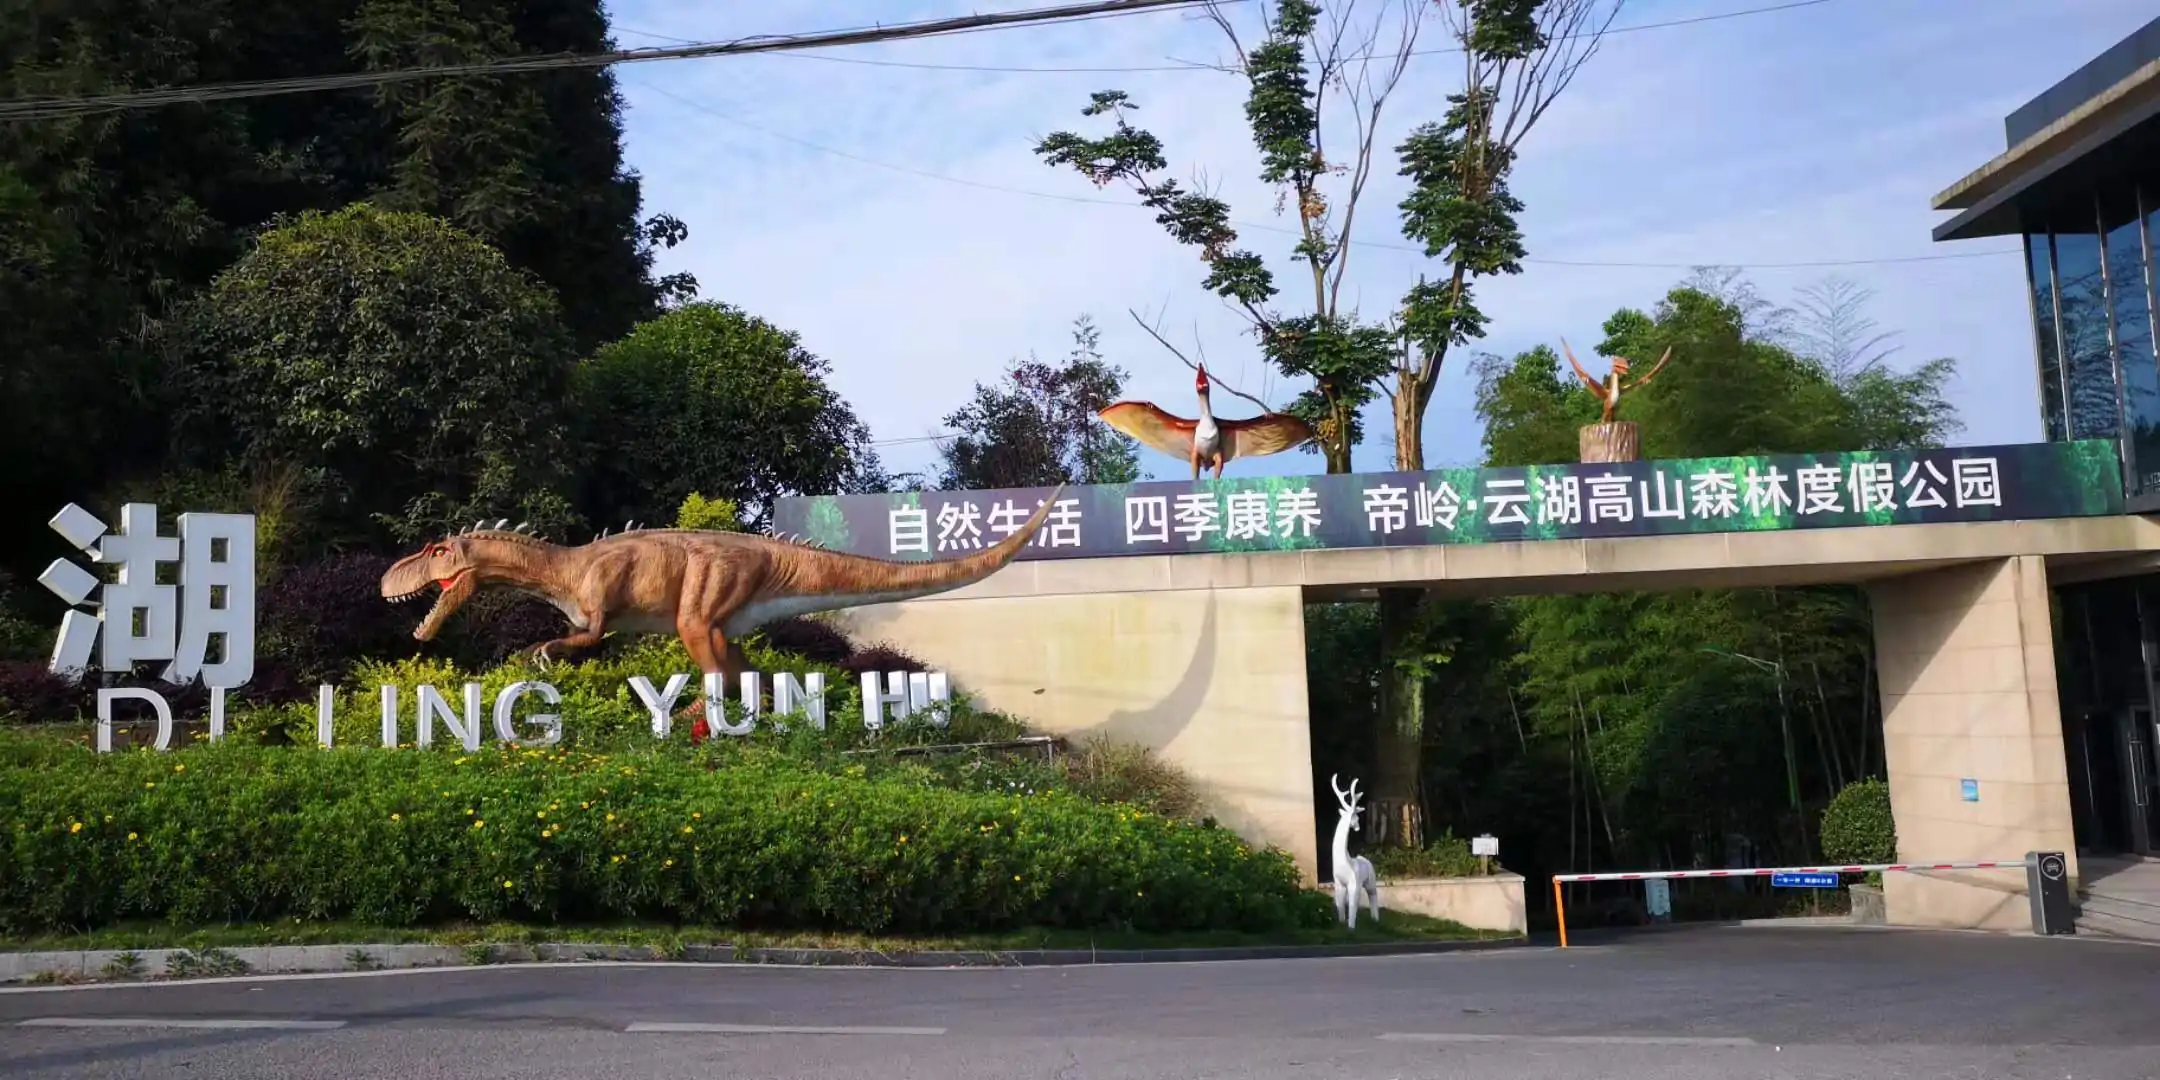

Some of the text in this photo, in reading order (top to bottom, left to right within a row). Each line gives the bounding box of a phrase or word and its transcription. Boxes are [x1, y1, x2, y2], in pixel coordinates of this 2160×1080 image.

[888, 457, 2003, 554] 自然生活 四季康养 帝岭·云湖高山森林度假公园
[36, 502, 256, 688] 湖
[97, 687, 225, 753] DI
[627, 671, 825, 740] YUN
[861, 670, 951, 730] HU
